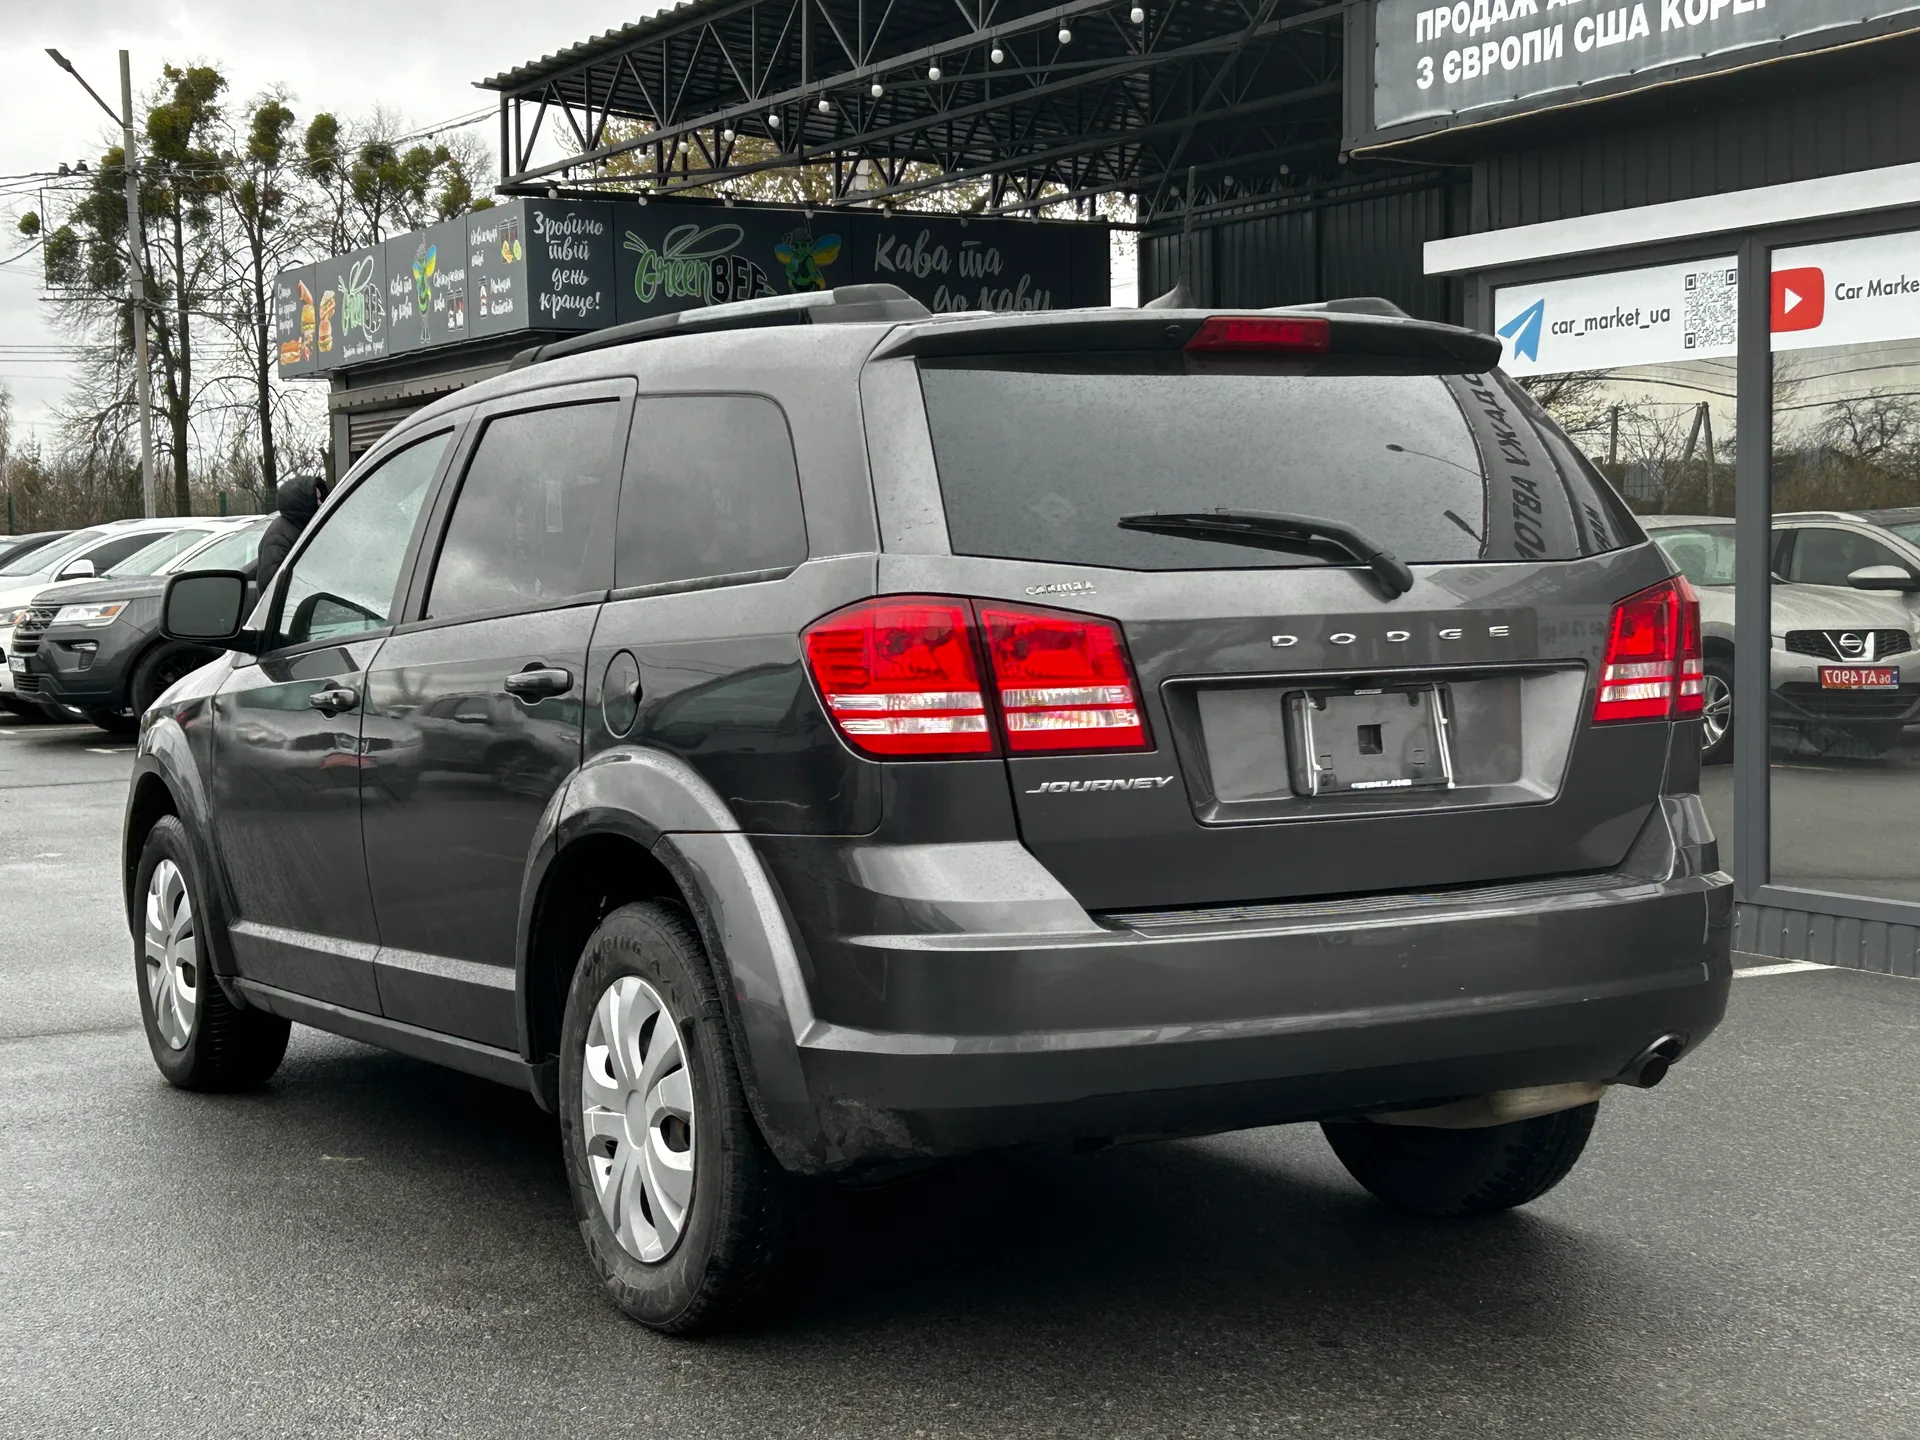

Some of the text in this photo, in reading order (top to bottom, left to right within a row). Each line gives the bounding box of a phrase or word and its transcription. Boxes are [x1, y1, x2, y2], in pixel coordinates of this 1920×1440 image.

[1416, 56, 1434, 90] З
[1442, 24, 1563, 84] ЄВРОПИ
[1573, 3, 1650, 53] США
[533, 210, 604, 243] Зробимо
[548, 236, 590, 260] твій
[874, 229, 1004, 279] Кава та
[551, 267, 590, 291] день
[1834, 274, 1920, 301] Car Marke
[539, 291, 601, 319] краще!
[1551, 306, 1671, 336] car_market_ua
[1271, 625, 1510, 648] DODGE
[1025, 775, 1174, 794] JOURNEY
